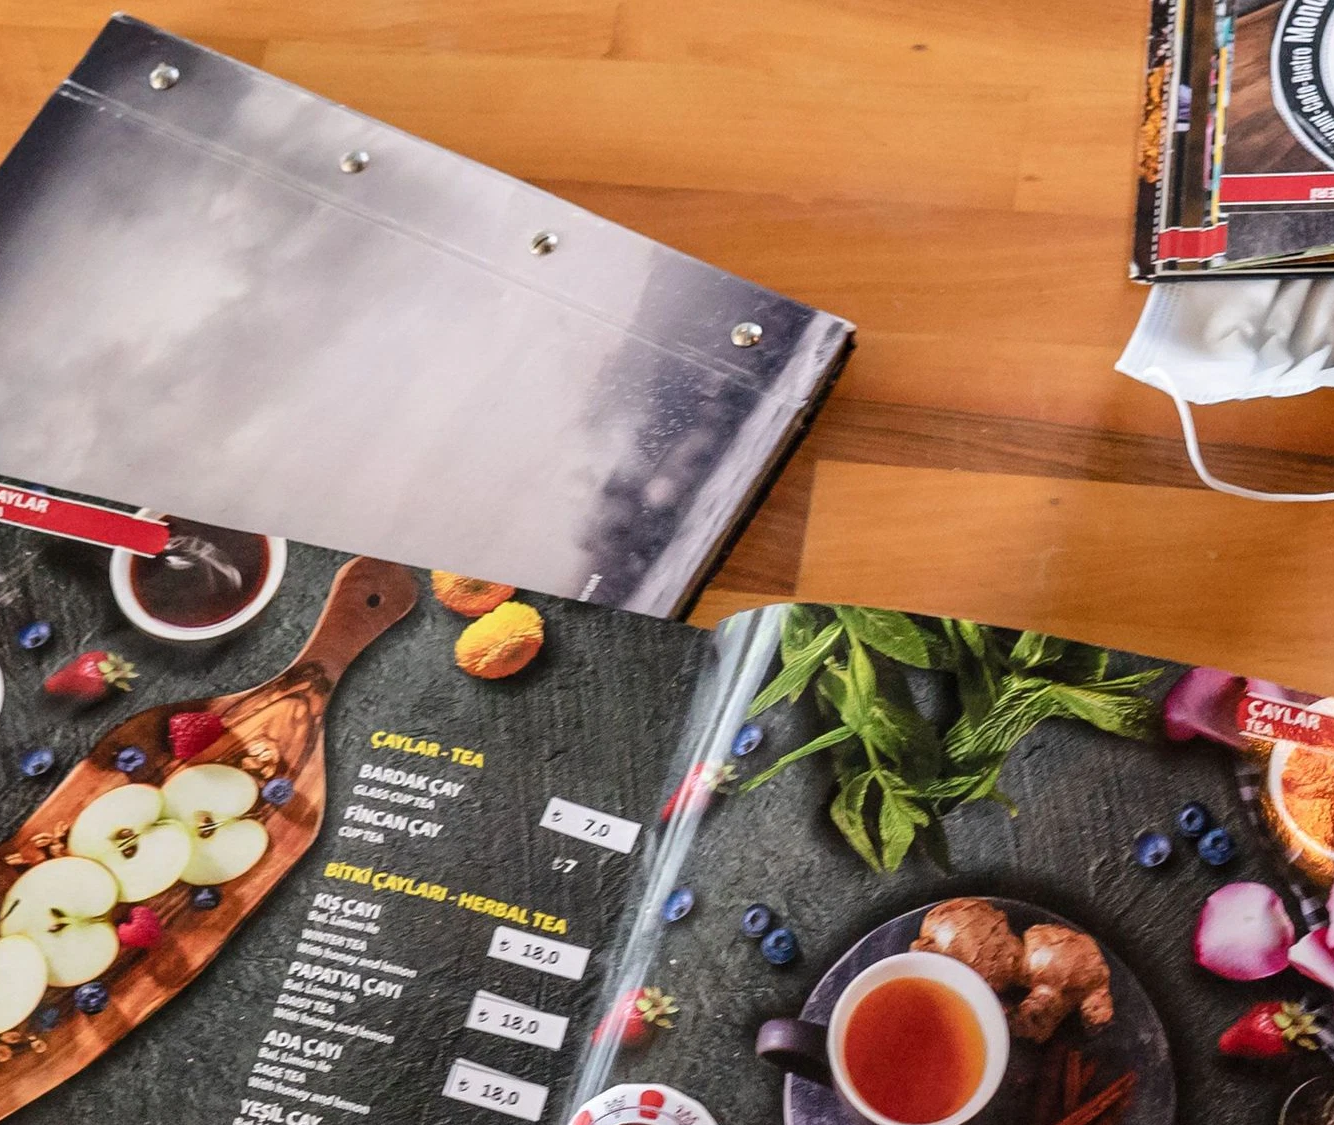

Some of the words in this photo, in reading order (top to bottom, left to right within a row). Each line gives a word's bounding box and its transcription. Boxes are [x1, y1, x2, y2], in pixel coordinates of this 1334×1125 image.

[1283, 0, 1327, 43] Mon
[1245, 717, 1275, 736] TEA
[1248, 700, 1321, 730] ÇAYLAR
[370, 730, 441, 757] ÇAYLAR
[451, 747, 484, 768] TEA
[352, 784, 391, 800] GLASS
[358, 764, 430, 790] BARDAK
[428, 779, 465, 798] ÇAY
[343, 804, 409, 831] FİNCAN
[408, 819, 444, 838] ÇAY
[584, 819, 610, 837] 7,0
[312, 892, 344, 914] KIŞ
[341, 899, 382, 920] ÇAYI
[323, 861, 374, 884] BİTKİ
[371, 872, 448, 902] ÇAYLARI
[457, 892, 529, 924] HERBAL
[533, 912, 566, 934] TEA
[522, 944, 559, 965] 18,0
[287, 961, 361, 990] PAPATYA
[362, 978, 404, 999] ÇAYI
[500, 1014, 539, 1034] 18,0
[262, 1030, 301, 1051] ADA
[302, 1039, 344, 1060] ÇAYI
[480, 1084, 519, 1105] 18,0
[240, 1099, 284, 1123] YEŞİL
